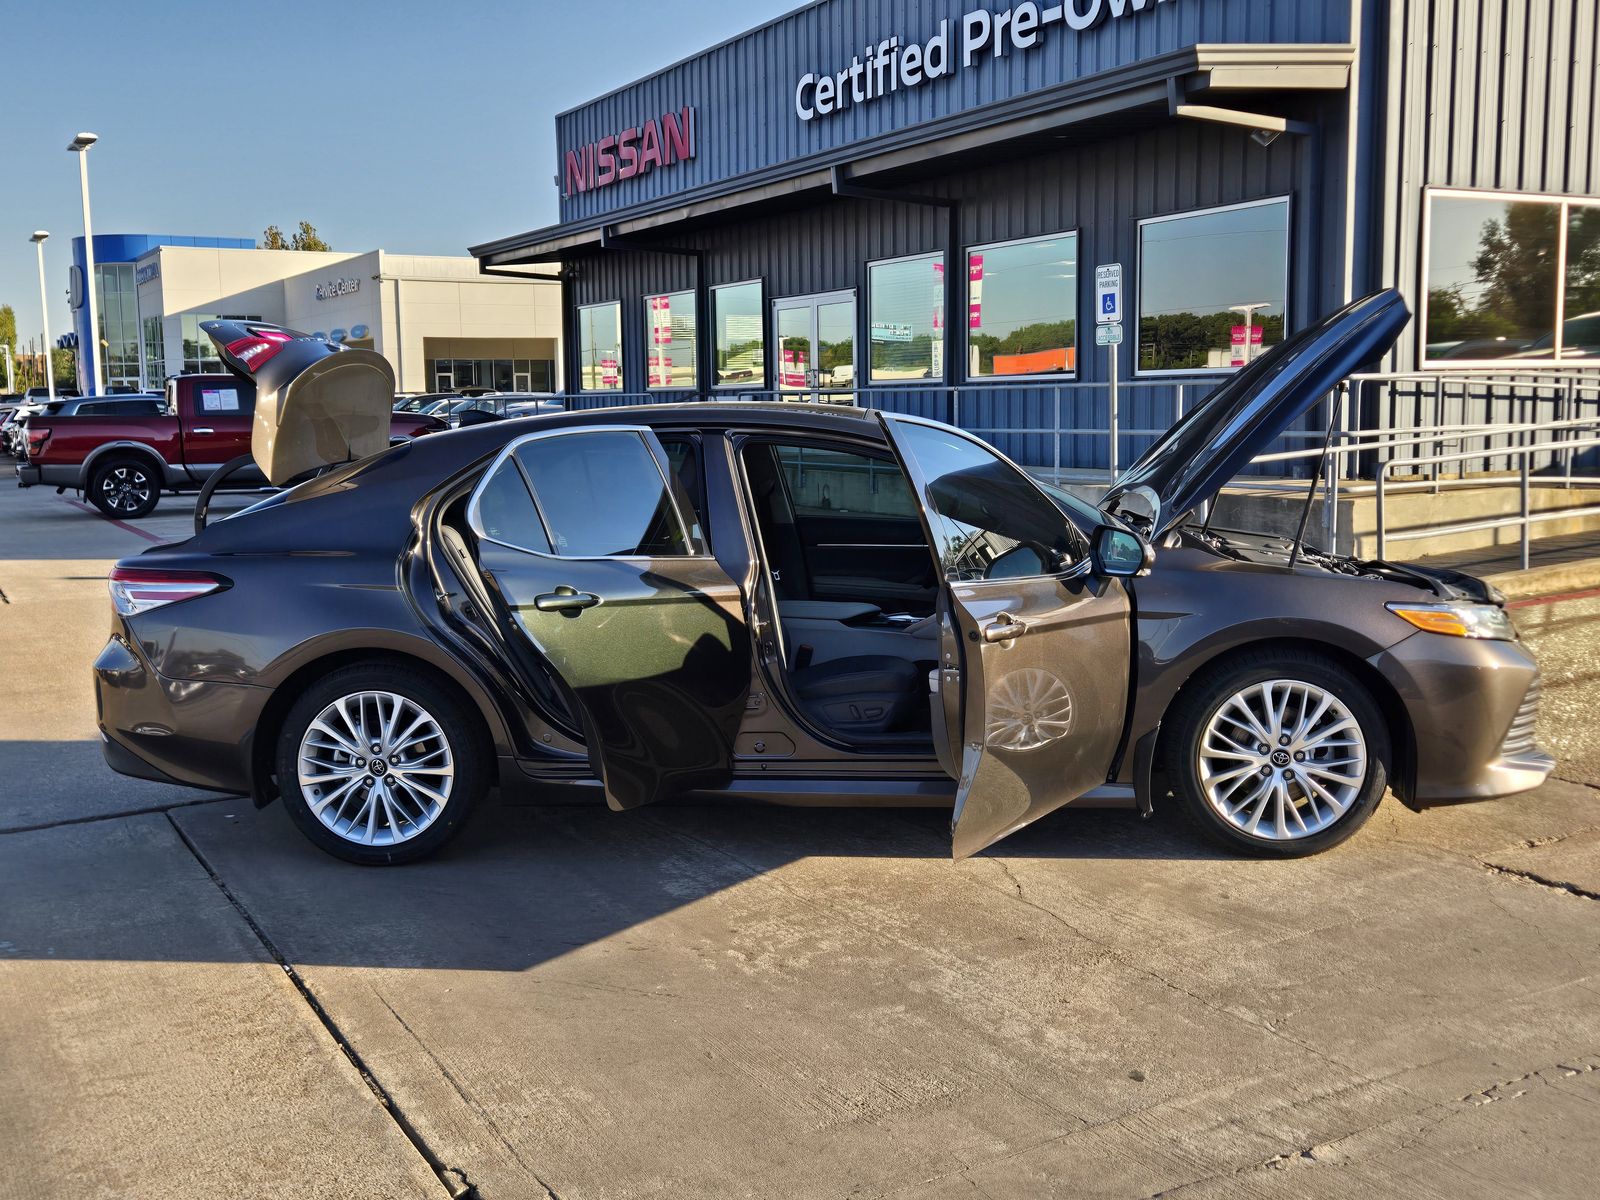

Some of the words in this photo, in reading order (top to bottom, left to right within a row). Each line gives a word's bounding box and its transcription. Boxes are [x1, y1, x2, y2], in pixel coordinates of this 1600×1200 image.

[796, 18, 951, 121] Certified
[566, 105, 692, 197] NISSAN
[1098, 269, 1119, 279] RESERVED
[1099, 279, 1118, 289] PARKING
